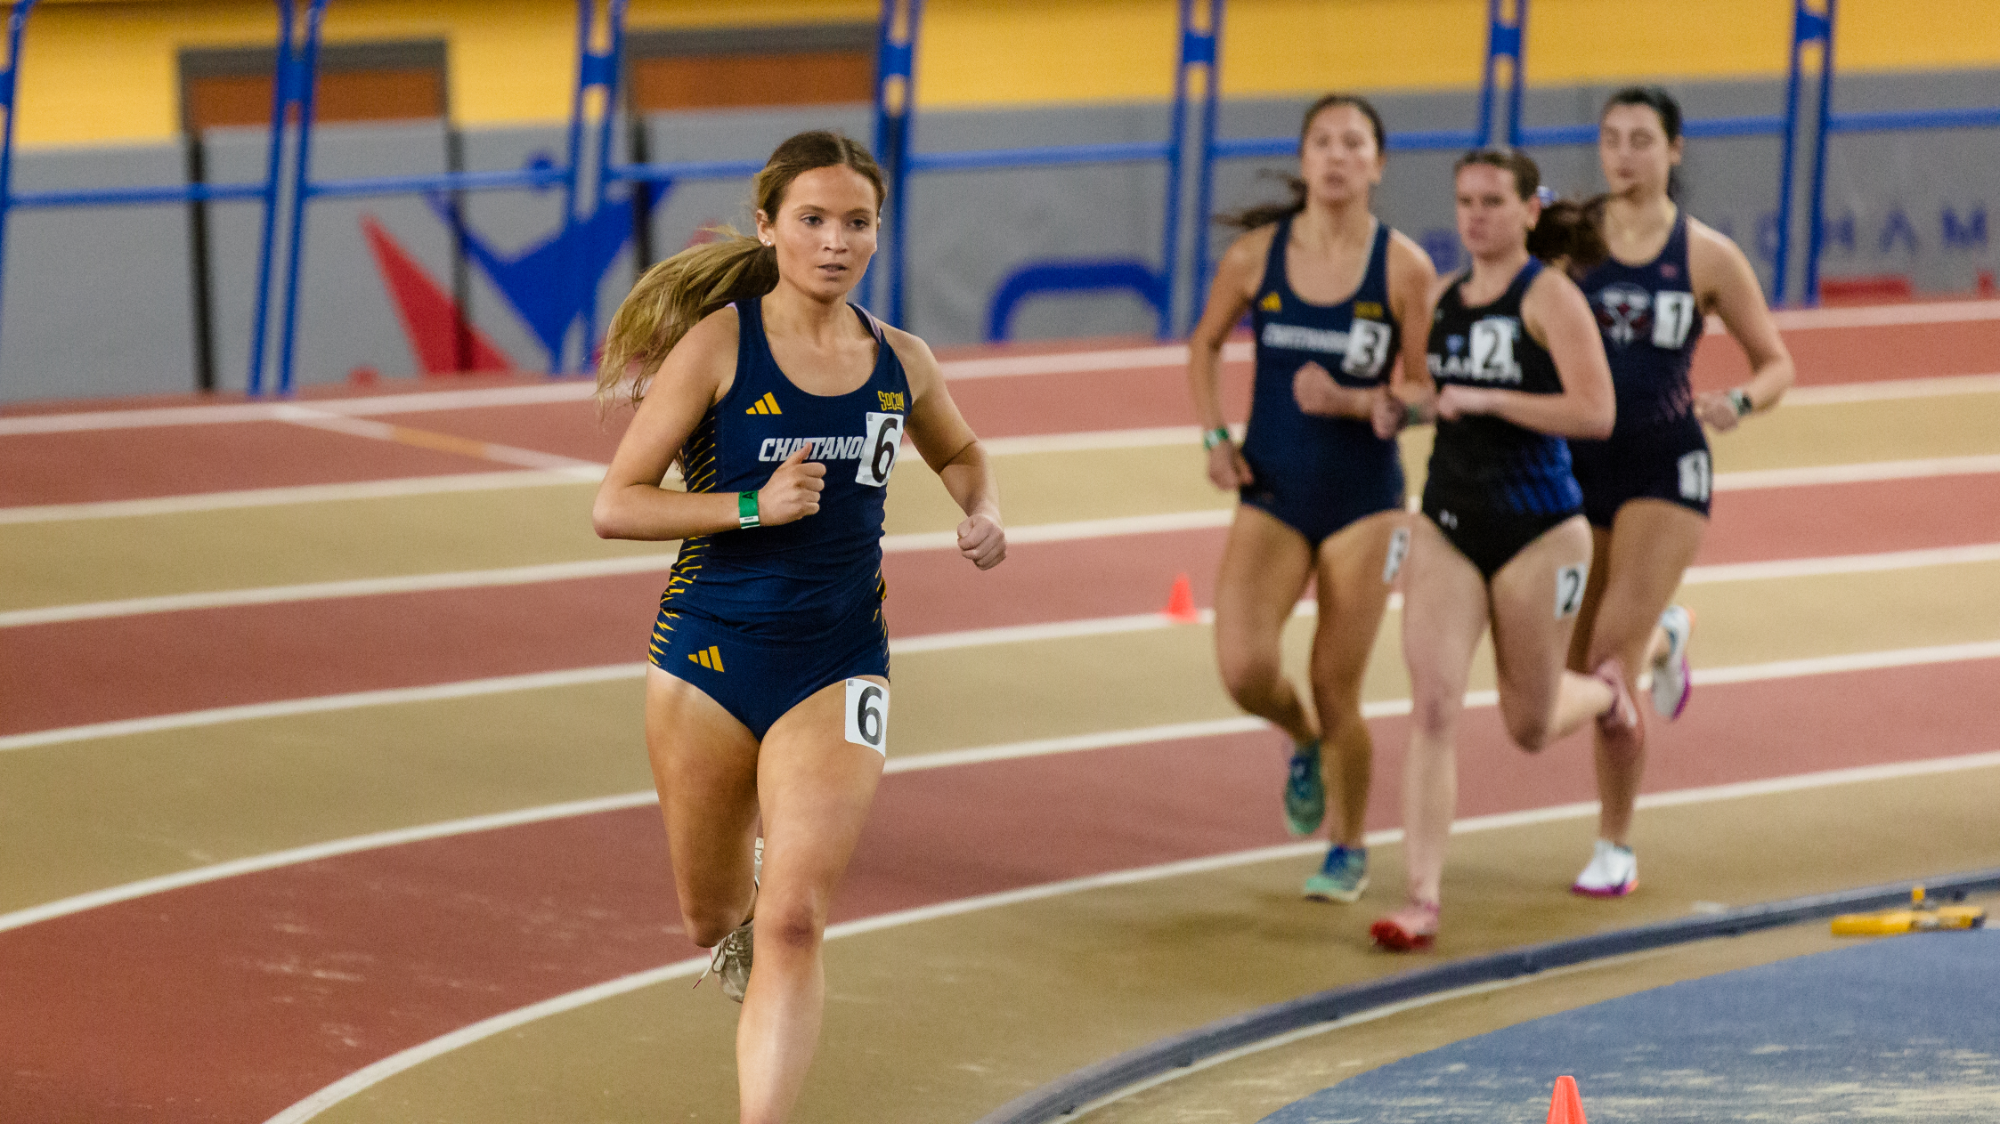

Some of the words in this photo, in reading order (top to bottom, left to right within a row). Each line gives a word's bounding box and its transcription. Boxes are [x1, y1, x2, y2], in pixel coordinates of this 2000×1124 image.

[1353, 323, 1379, 376] 3
[1481, 321, 1504, 370] 2
[758, 435, 867, 462] CHATTANO
[871, 417, 898, 483] 6
[1562, 567, 1582, 615] 2
[857, 685, 883, 746] 6
